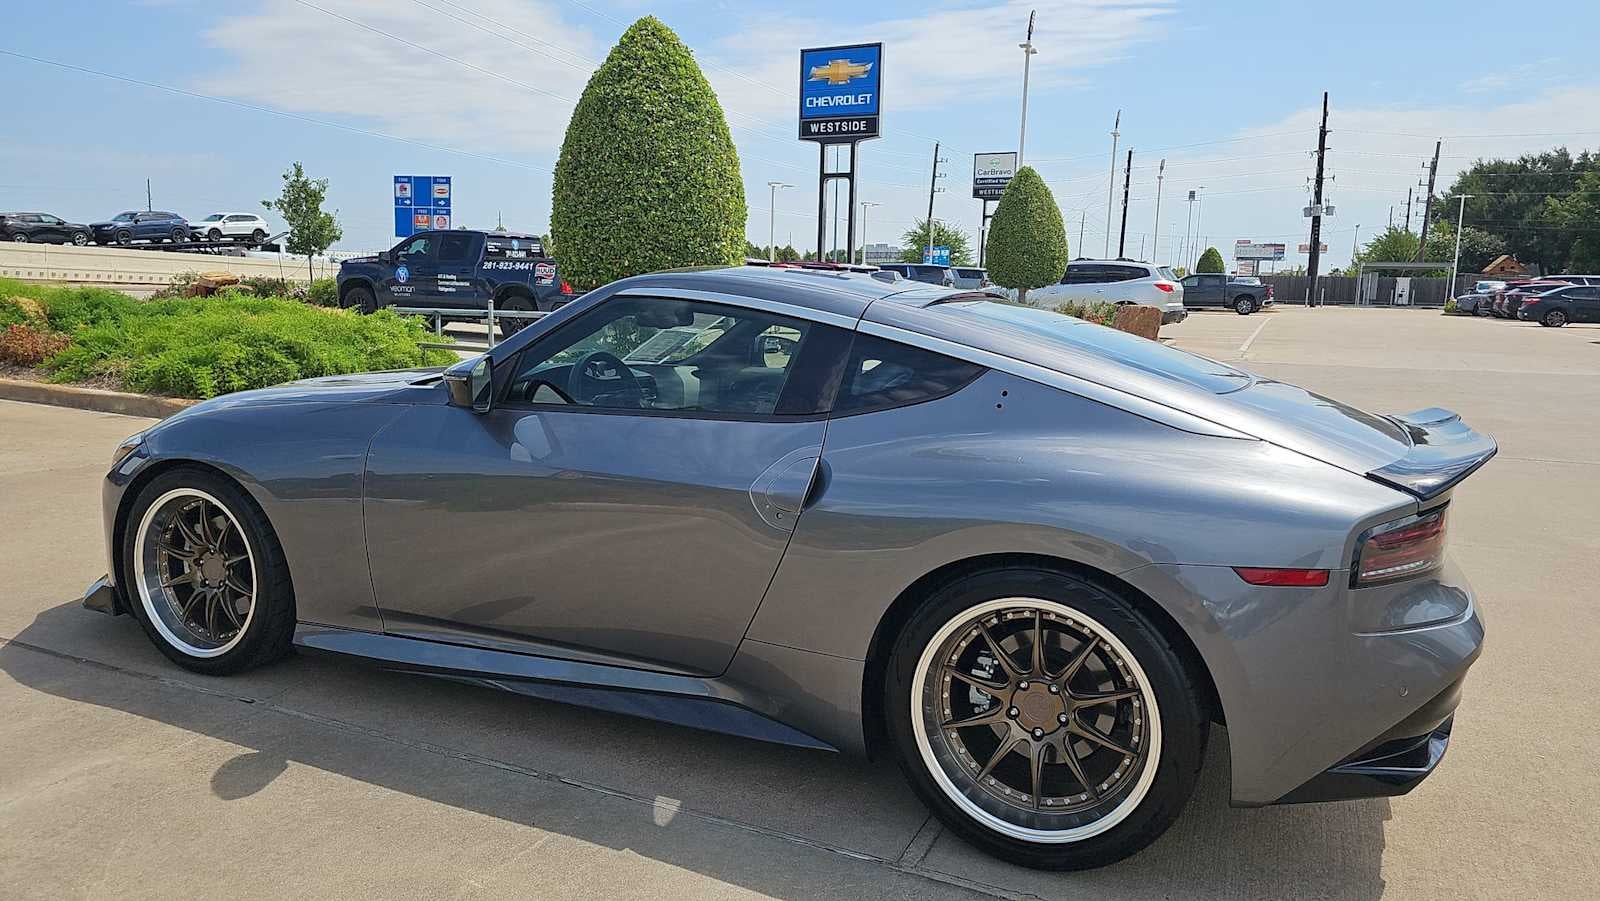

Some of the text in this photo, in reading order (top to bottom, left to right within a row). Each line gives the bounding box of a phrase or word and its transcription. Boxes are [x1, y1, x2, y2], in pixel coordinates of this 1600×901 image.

[806, 93, 873, 108] CHEVROLET
[810, 121, 867, 133] WESTSIDE
[977, 168, 1012, 176] CarBravo
[482, 261, 534, 270] 281-923-9441
